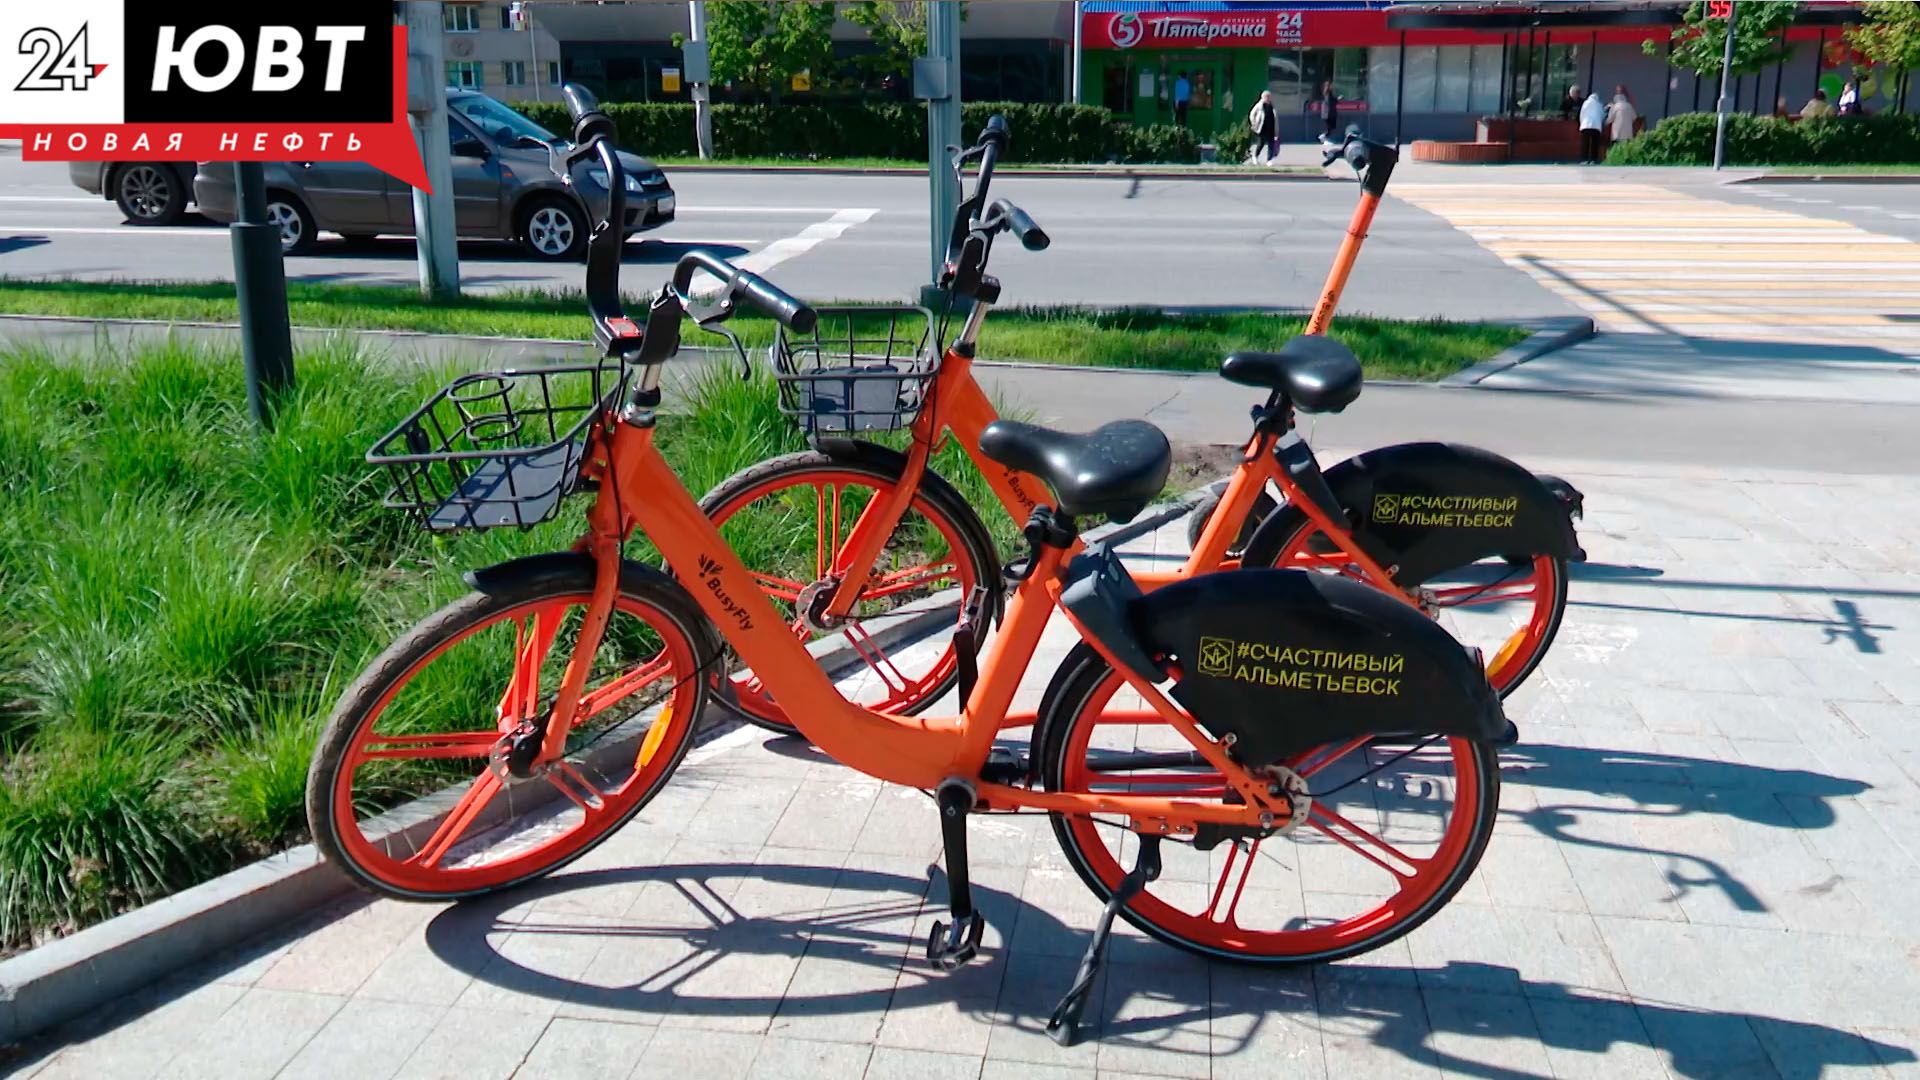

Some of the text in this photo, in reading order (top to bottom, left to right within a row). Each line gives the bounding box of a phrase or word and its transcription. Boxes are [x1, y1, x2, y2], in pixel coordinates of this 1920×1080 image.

[1709, 0, 1730, 17] 55
[1276, 12, 1303, 29] 24
[1401, 496, 1517, 511] #СЧАСТЛИВЫЙ
[1399, 512, 1514, 527] АЛЬМЕТЬЕВСК
[706, 577, 754, 631] BusyFly
[1236, 642, 1404, 673] #СЧАСТЛИВЫЙ
[1234, 665, 1400, 695] АЛЬМЕТЬЕВСК
